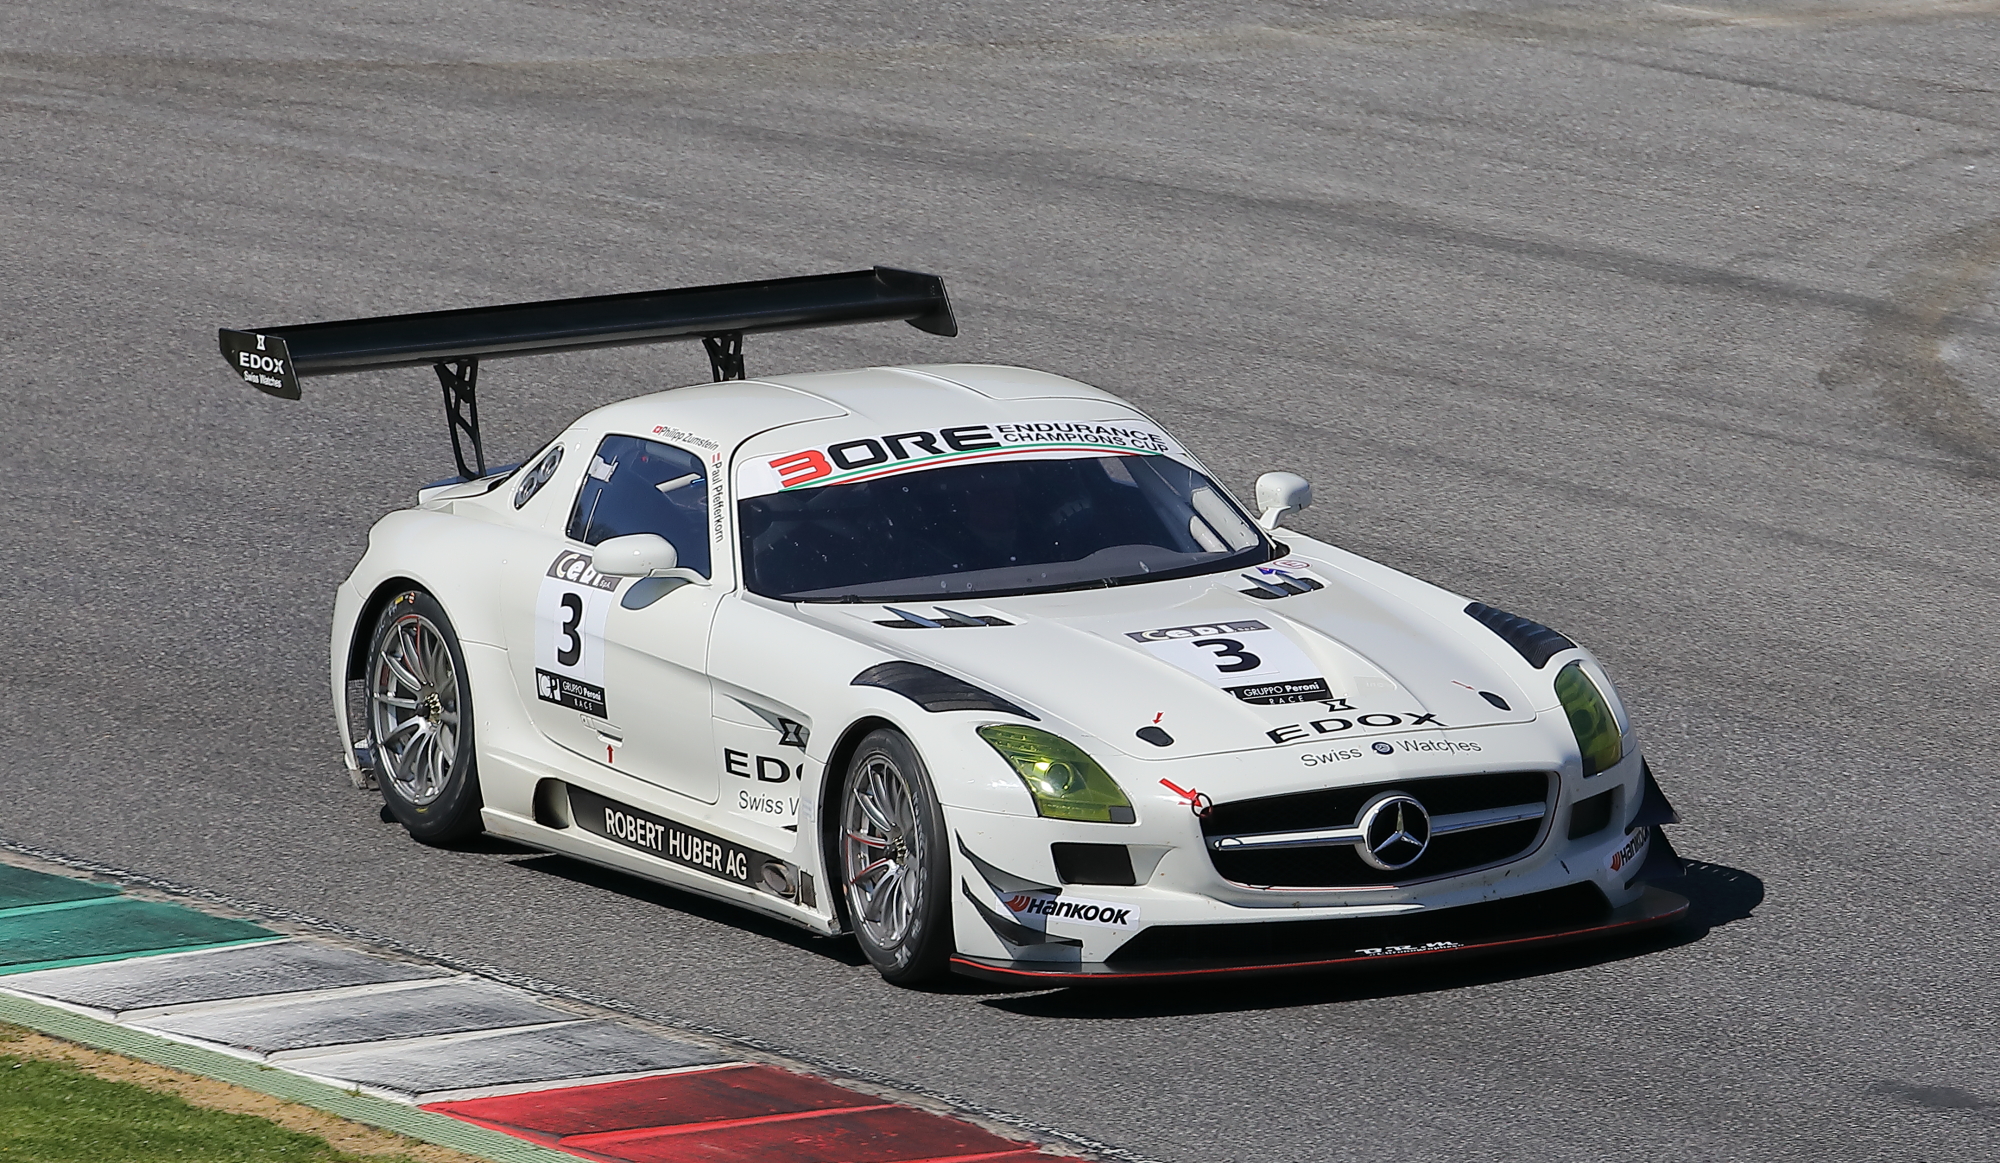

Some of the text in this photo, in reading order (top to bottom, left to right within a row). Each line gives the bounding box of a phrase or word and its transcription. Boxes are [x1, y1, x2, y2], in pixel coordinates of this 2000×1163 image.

[239, 352, 285, 375] EDOX
[682, 432, 720, 451] Zumstein
[999, 423, 1164, 443] ENDURANCE
[1003, 433, 1169, 453] CHAMPIONS CUP
[711, 462, 725, 544] Paul Pfefferkorn
[557, 592, 583, 667] 3
[1191, 638, 1262, 673] 3
[562, 680, 602, 701] GRUPPO Peroni
[1243, 685, 1283, 697] GRUPPO
[1284, 681, 1320, 693] Peroni
[1268, 695, 1305, 705] RACE
[573, 698, 593, 711] RACE
[1265, 712, 1449, 744] EDOX
[1300, 739, 1482, 767] Swiss Watches
[738, 790, 784, 815] Swiss
[604, 807, 747, 880] ROBERT HUBER AG
